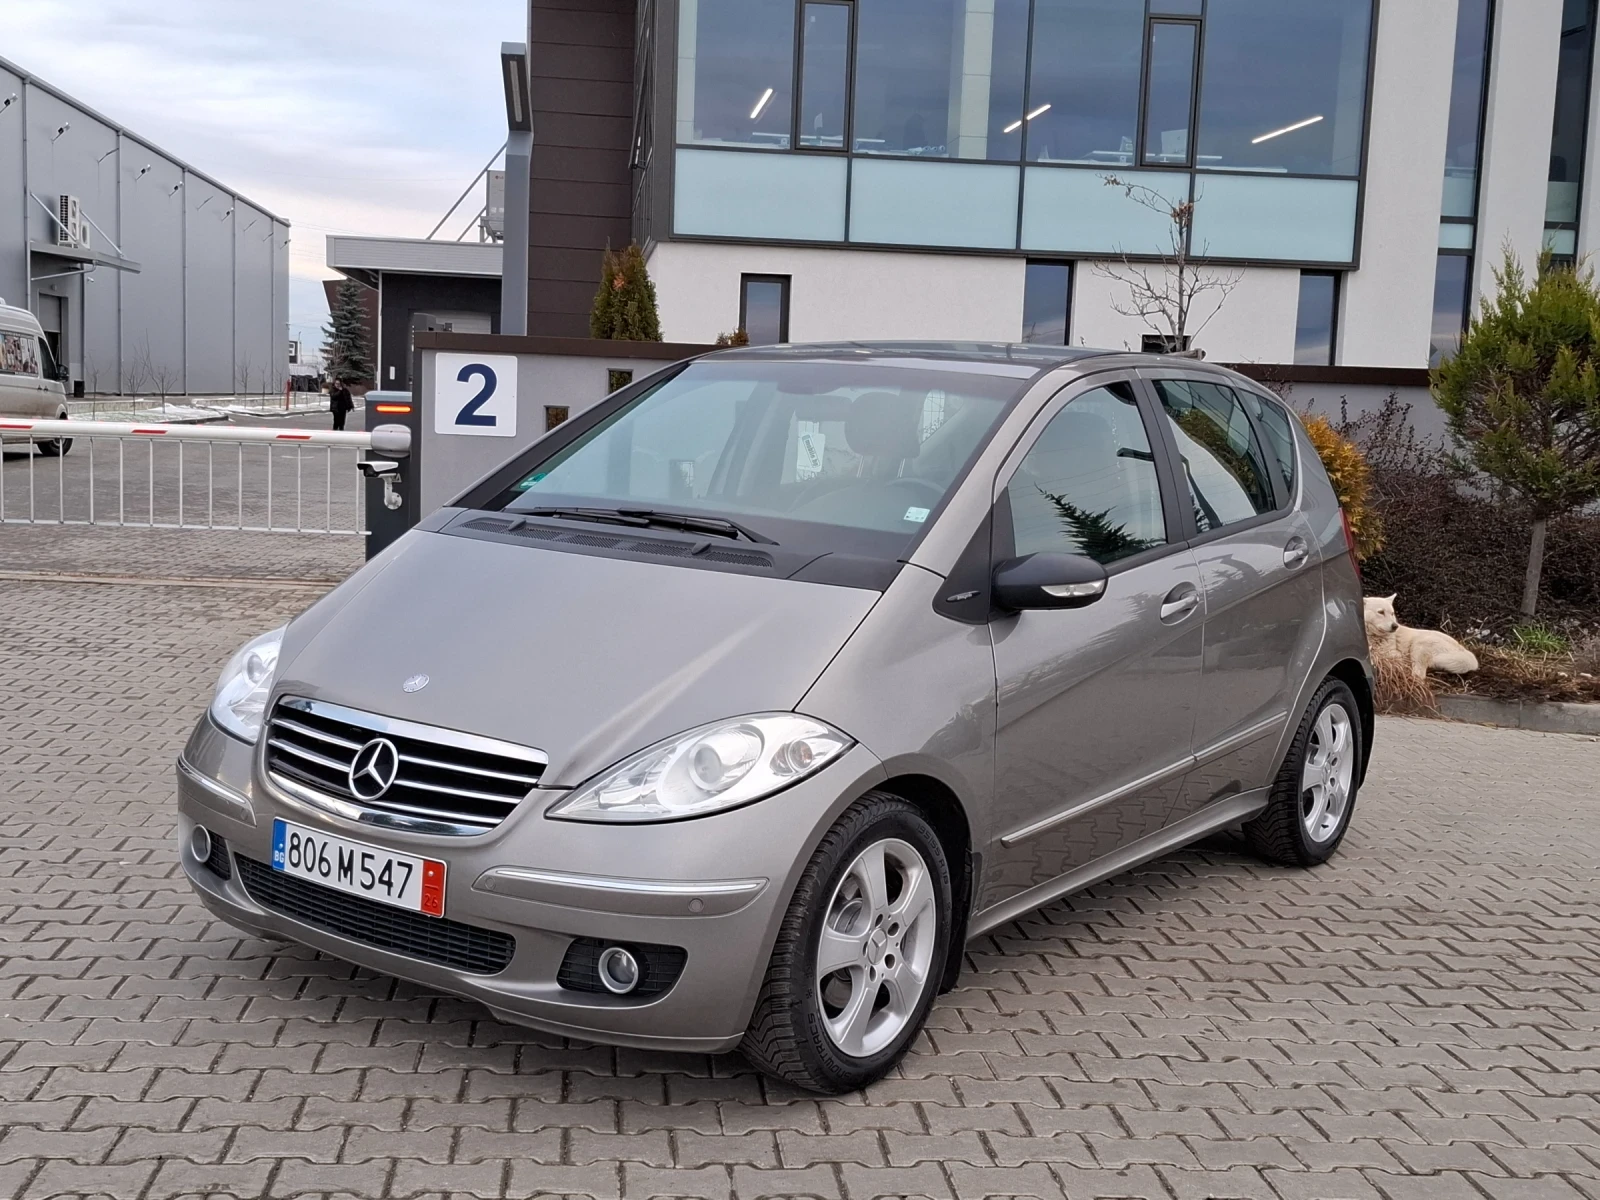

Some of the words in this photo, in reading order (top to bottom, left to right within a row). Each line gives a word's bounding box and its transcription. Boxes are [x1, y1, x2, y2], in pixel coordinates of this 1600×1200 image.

[455, 363, 497, 427] 2
[274, 850, 285, 863] BG
[424, 893, 438, 908] 26
